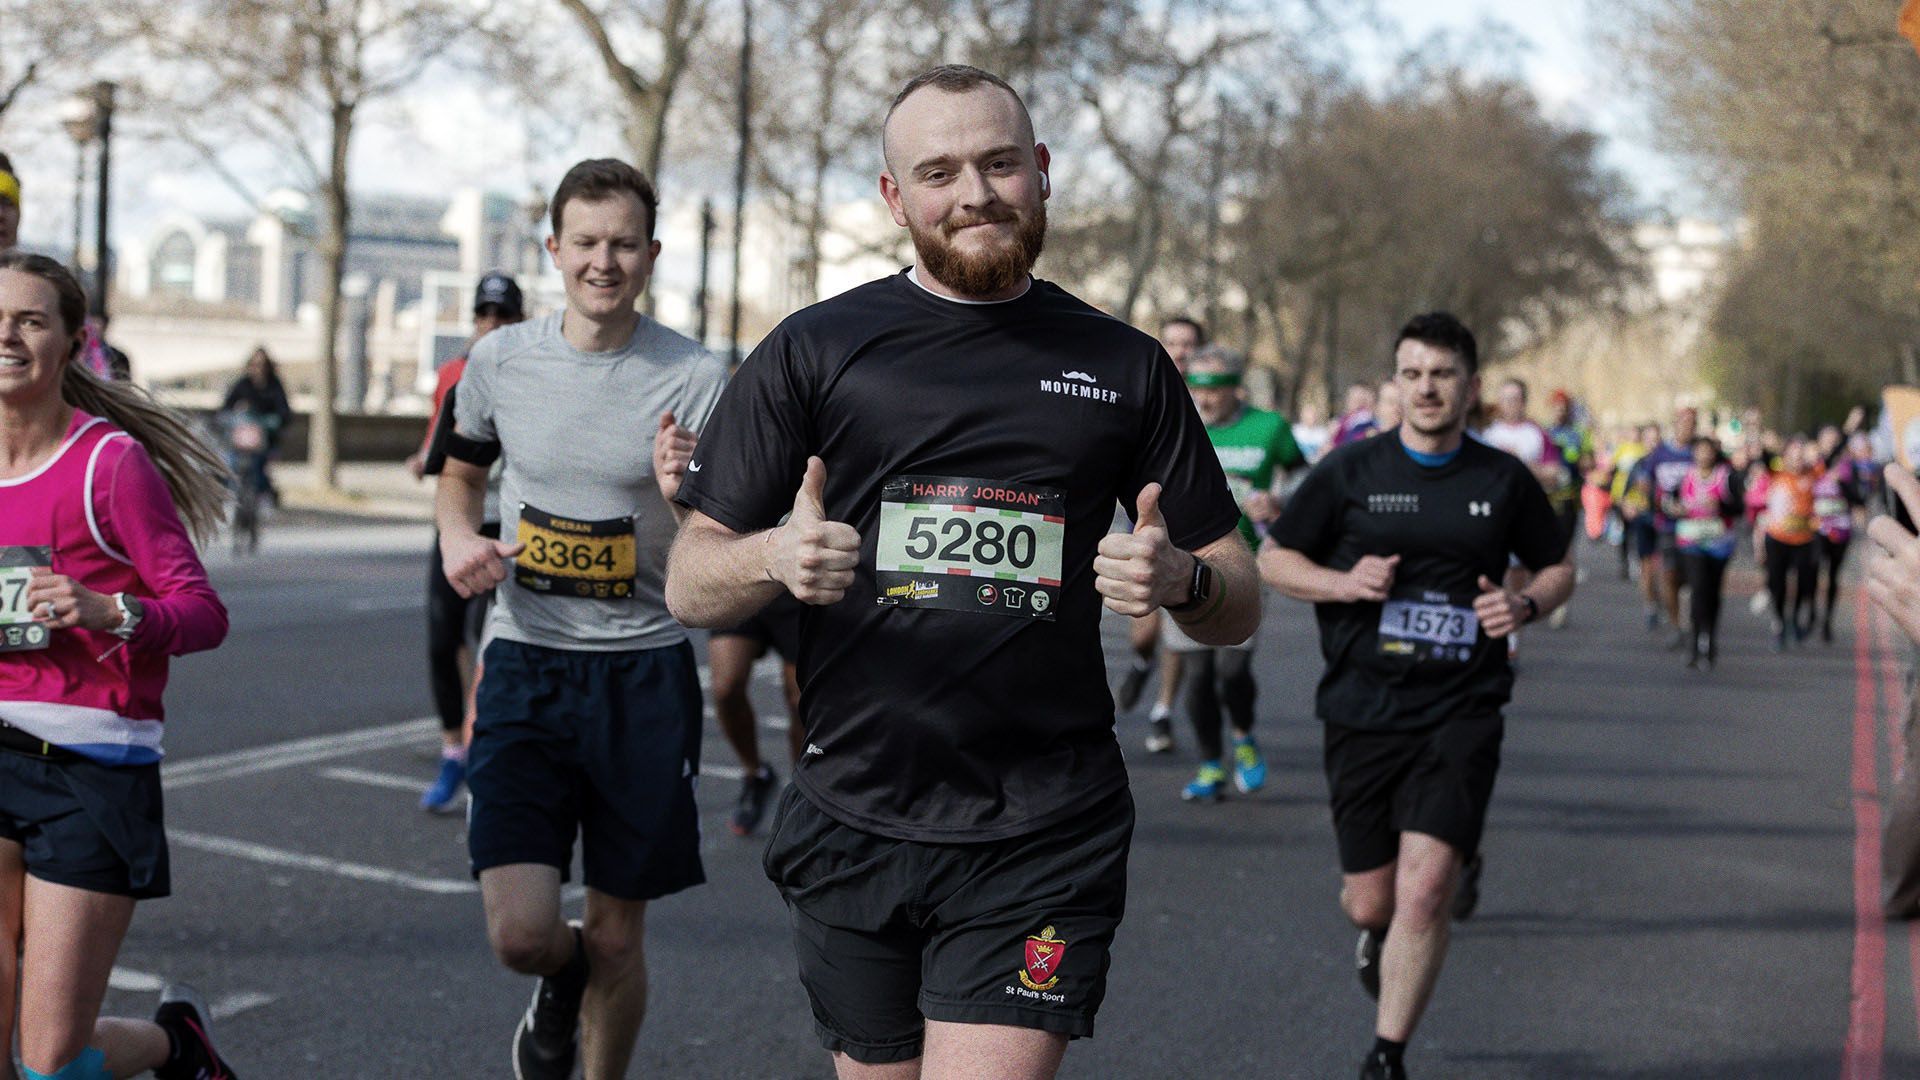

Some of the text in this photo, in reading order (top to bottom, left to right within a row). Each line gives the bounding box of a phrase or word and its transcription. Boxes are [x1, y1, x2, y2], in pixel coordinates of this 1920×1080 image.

[913, 483, 1039, 506] HARRY JORDAN
[529, 535, 616, 572] 3364
[904, 516, 1036, 569] 5280
[886, 585, 910, 597] LONDON
[1037, 600, 1043, 608] 3
[1400, 607, 1466, 638] 1573
[1005, 985, 1064, 1003] St Paul's Sport
